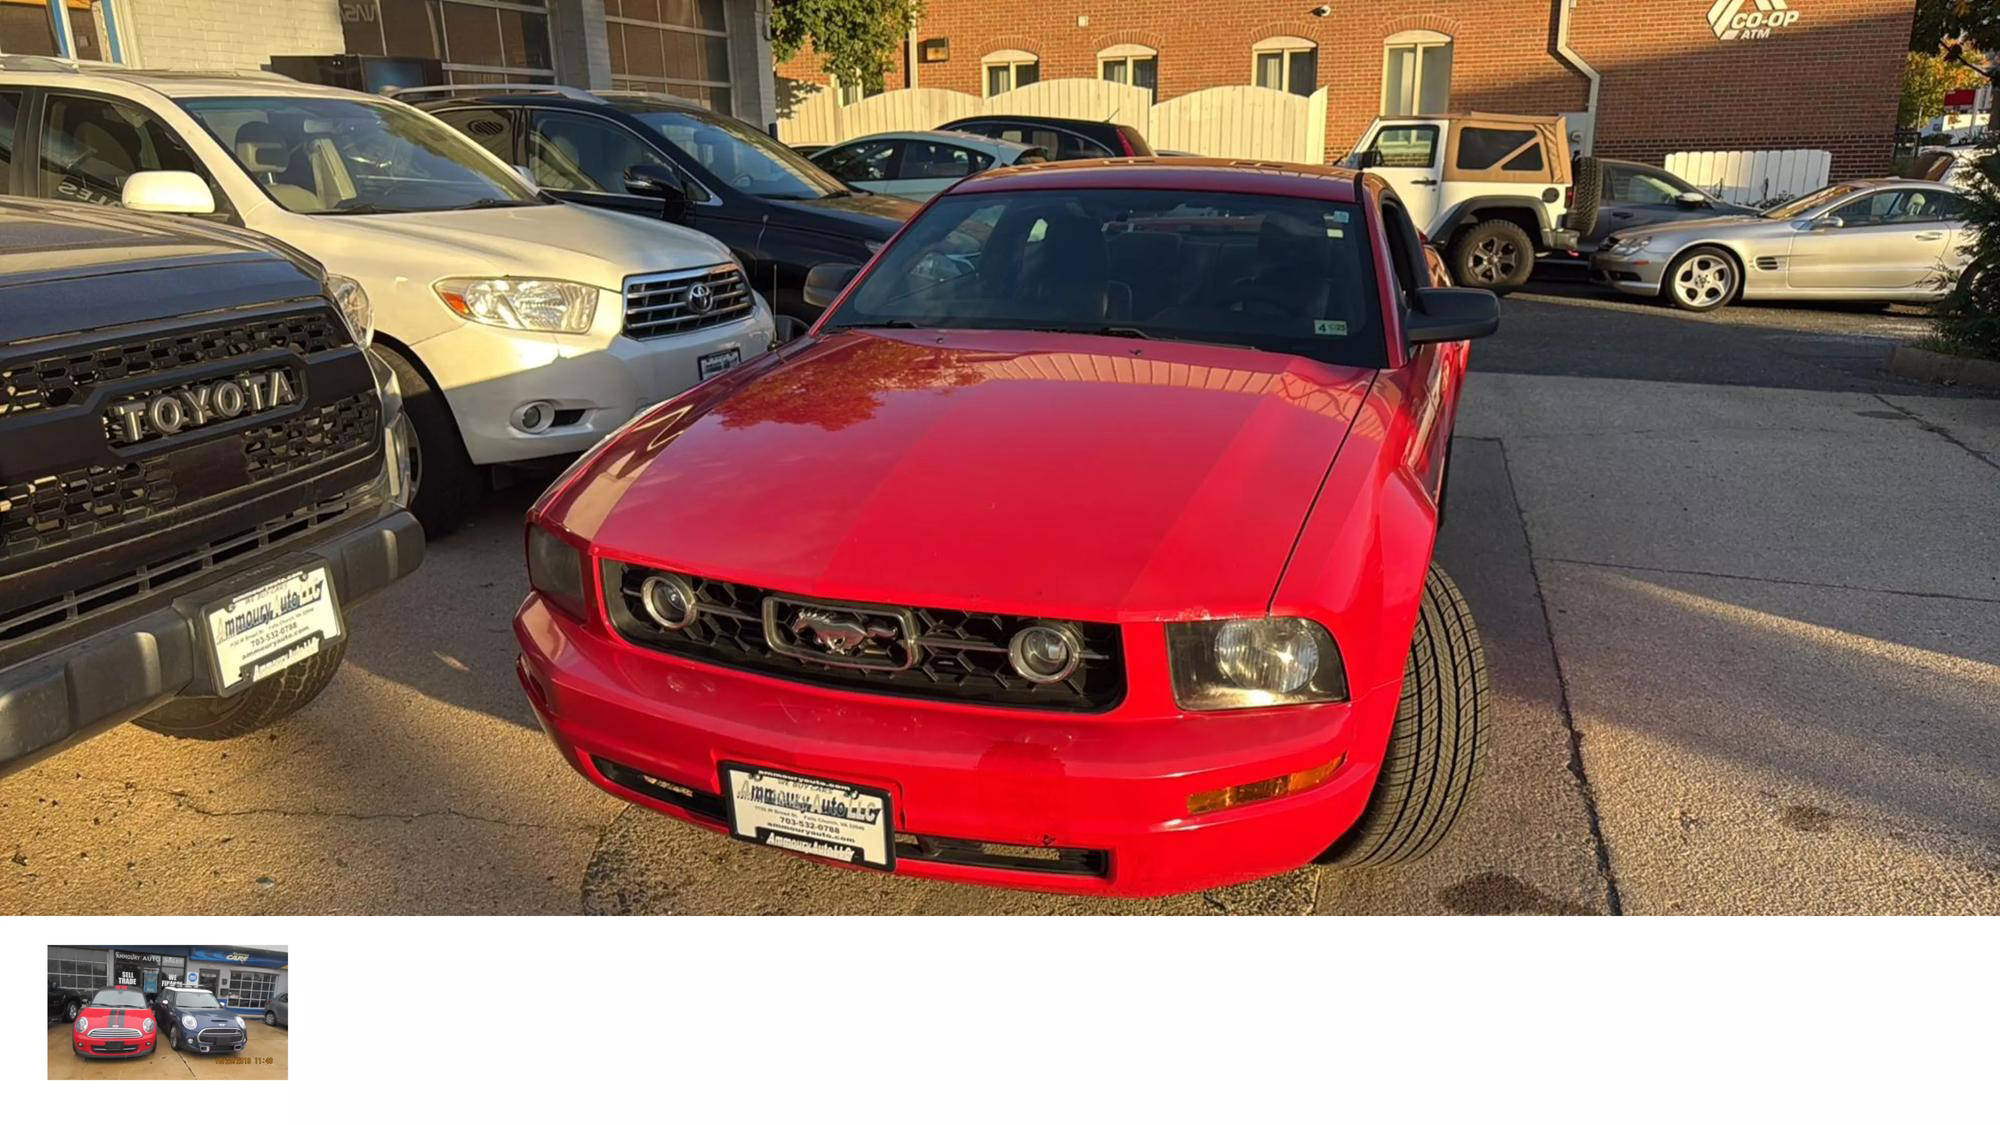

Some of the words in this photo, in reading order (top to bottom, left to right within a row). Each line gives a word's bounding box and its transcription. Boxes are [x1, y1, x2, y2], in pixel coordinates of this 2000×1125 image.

[1731, 10, 1800, 29] CO-OP
[1741, 28, 1771, 39] ATM
[106, 370, 296, 442] TOYOTA
[251, 622, 297, 648] 703-532-0788
[758, 770, 851, 791] ammouryauto.com
[737, 780, 812, 814] Ammoury
[813, 794, 848, 819] Auto
[847, 799, 881, 826] LLC
[767, 821, 855, 843] ammouryauto.com
[780, 816, 840, 835] 703-532-0788
[766, 832, 812, 854] Ammoury
[225, 954, 249, 962] CARE
[168, 973, 178, 981] WE
